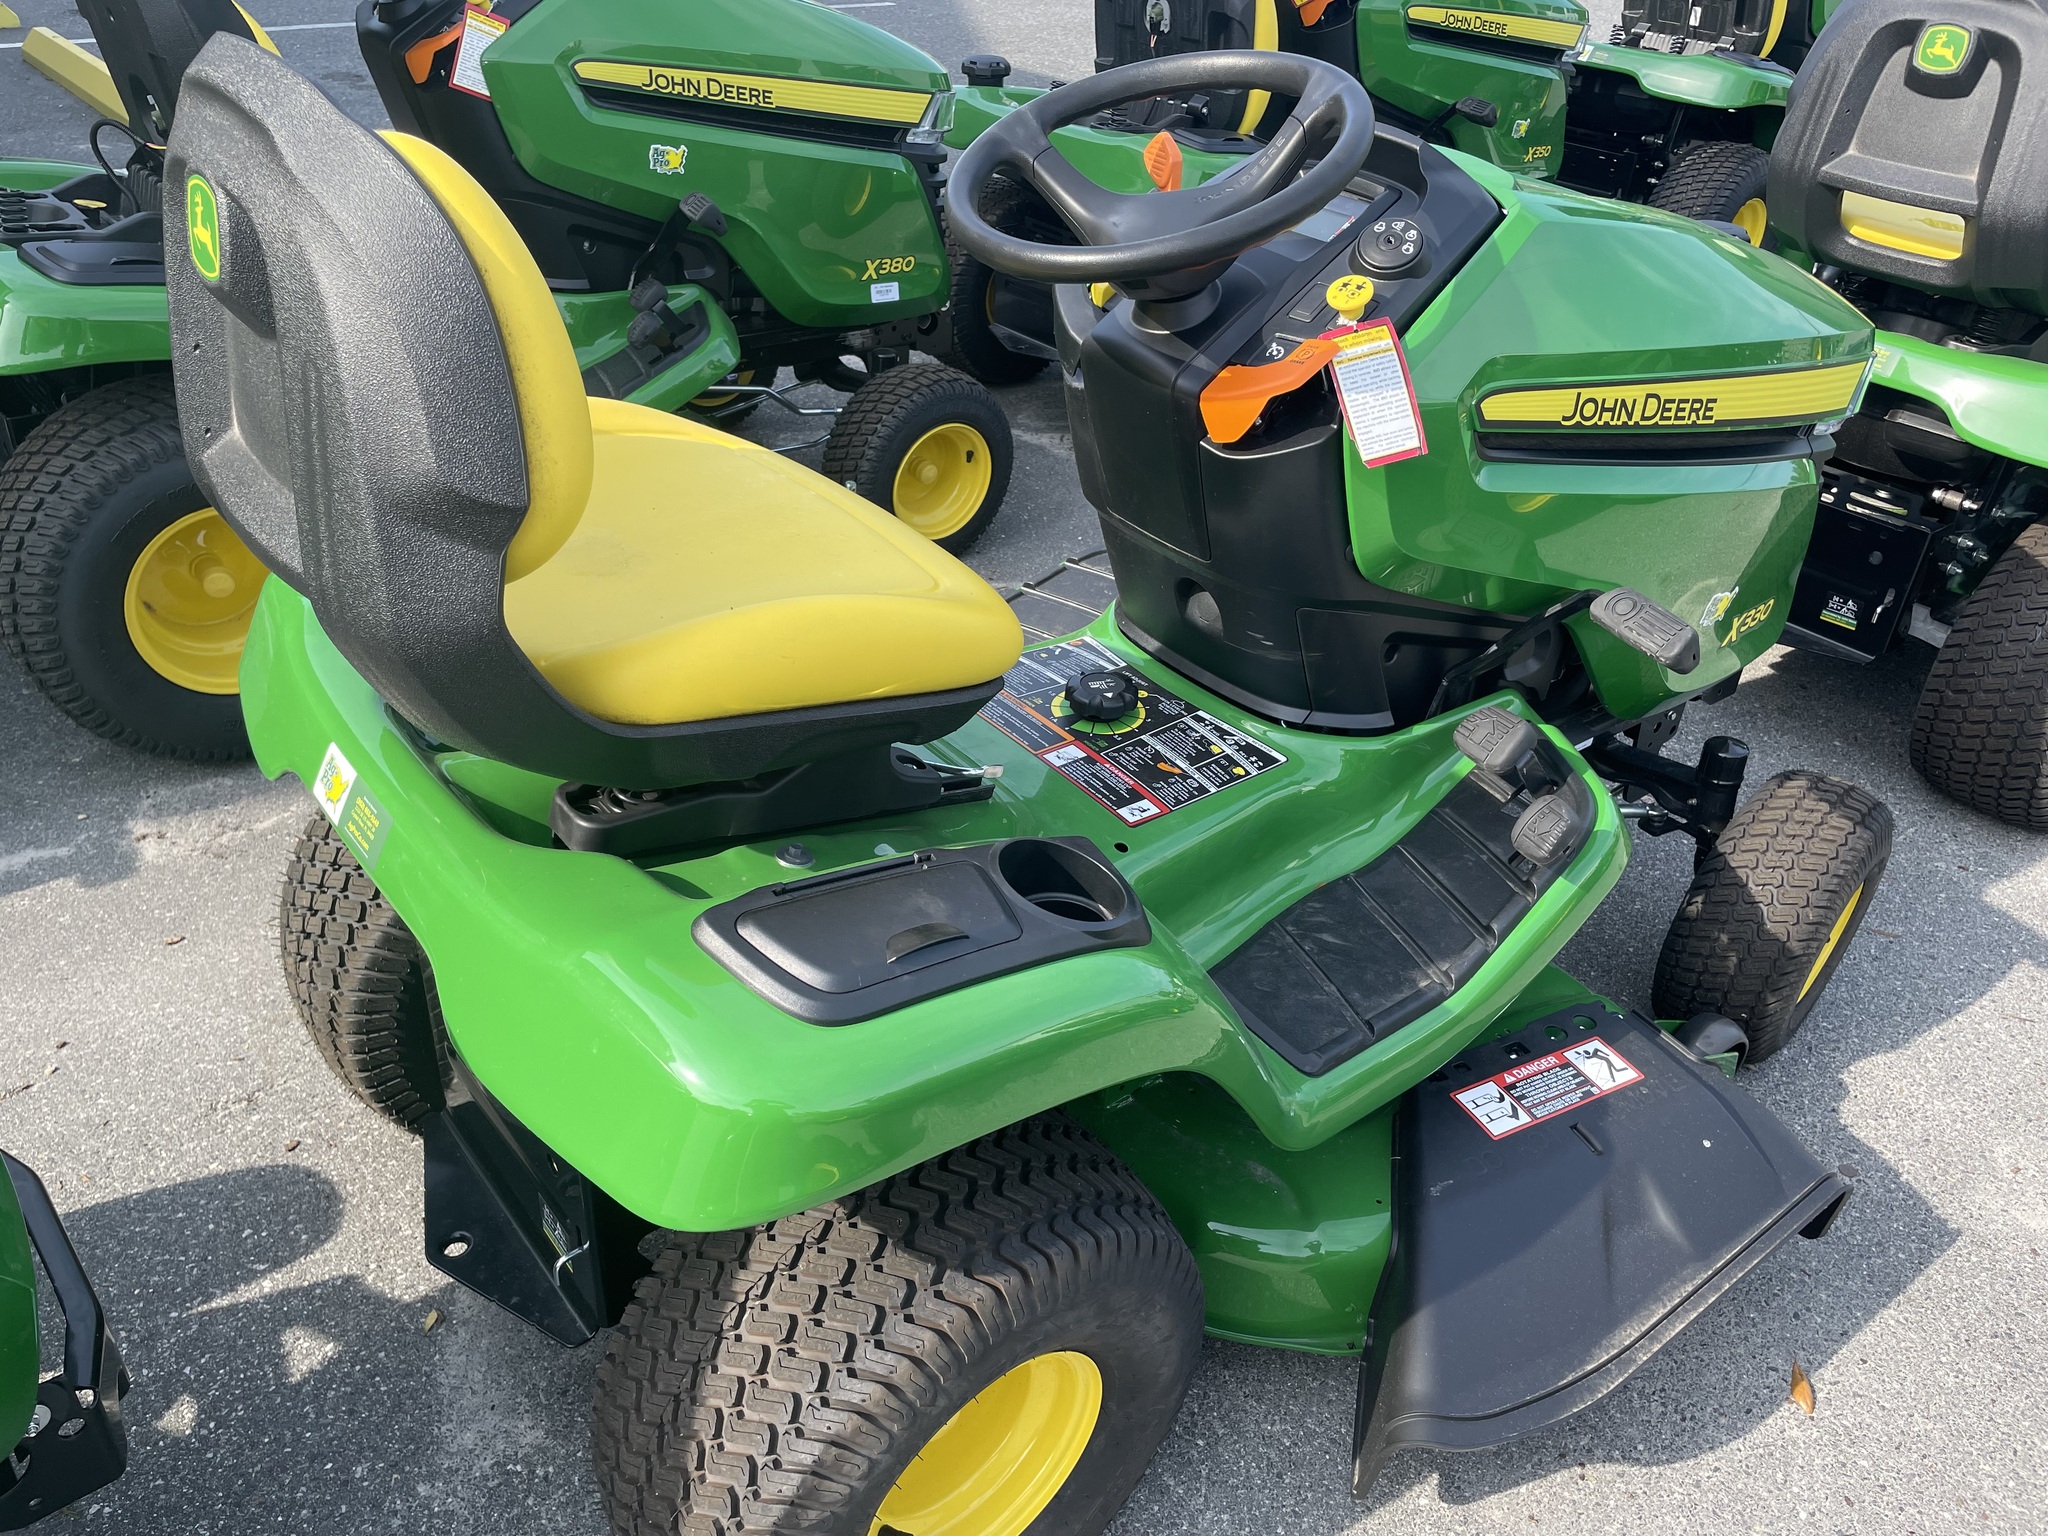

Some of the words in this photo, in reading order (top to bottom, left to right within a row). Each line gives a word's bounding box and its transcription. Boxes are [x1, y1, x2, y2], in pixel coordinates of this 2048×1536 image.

[1440, 10, 1471, 27] JOHN
[1473, 16, 1508, 36] DEERE
[641, 69, 701, 97] JOHN
[706, 78, 775, 107] DEERE
[1523, 145, 1552, 162] X350
[860, 255, 916, 281] X380
[1561, 392, 1637, 423] JOHN
[1639, 393, 1718, 423] DEERE
[1720, 597, 1775, 648] X330
[1110, 766, 1135, 786] DANGER
[1512, 1056, 1560, 1078] DANGER
[1515, 1074, 1544, 1087] ROTATING
[1542, 1067, 1562, 1076] BLADE
[1524, 1086, 1550, 1097] THROWN
[1547, 1076, 1574, 1088] OBJECTS
